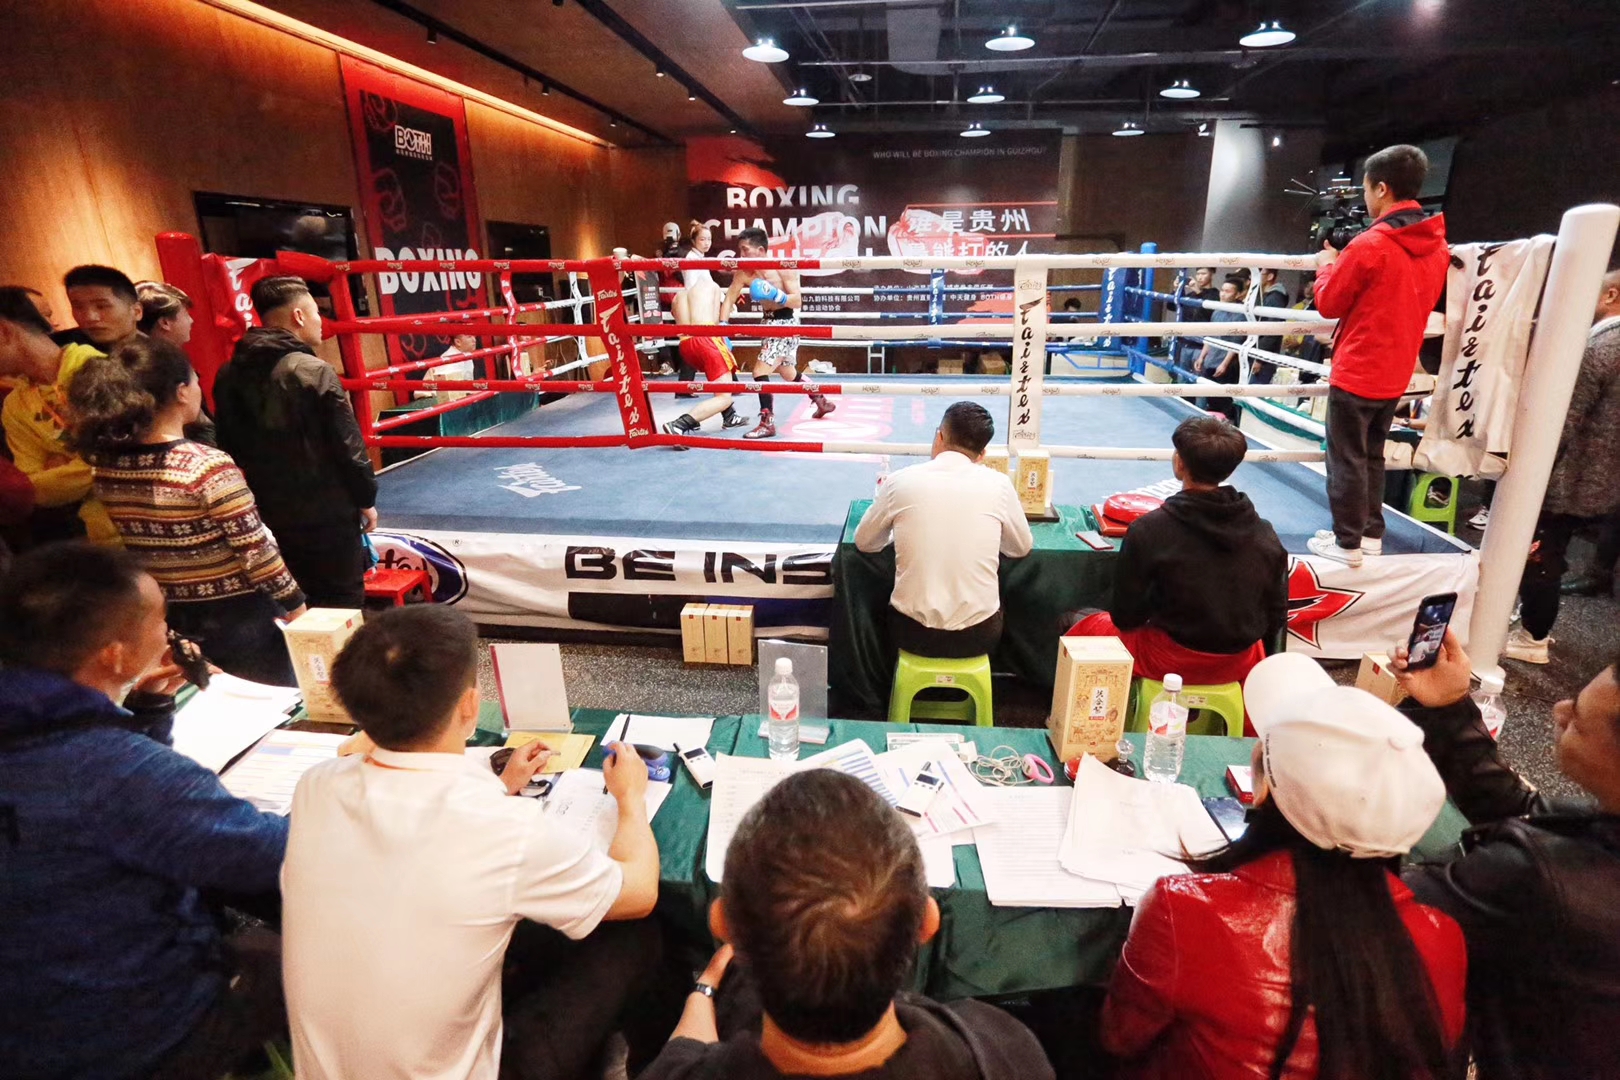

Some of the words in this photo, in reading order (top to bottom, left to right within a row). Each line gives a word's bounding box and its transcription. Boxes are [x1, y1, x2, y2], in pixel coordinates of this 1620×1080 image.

[893, 151, 910, 159] WILL
[954, 148, 995, 157] CHAMPION
[727, 184, 860, 208] BOXING
[908, 208, 1031, 232] 谁是贵州
[375, 247, 481, 294] BOXING
[565, 546, 677, 582] BE
